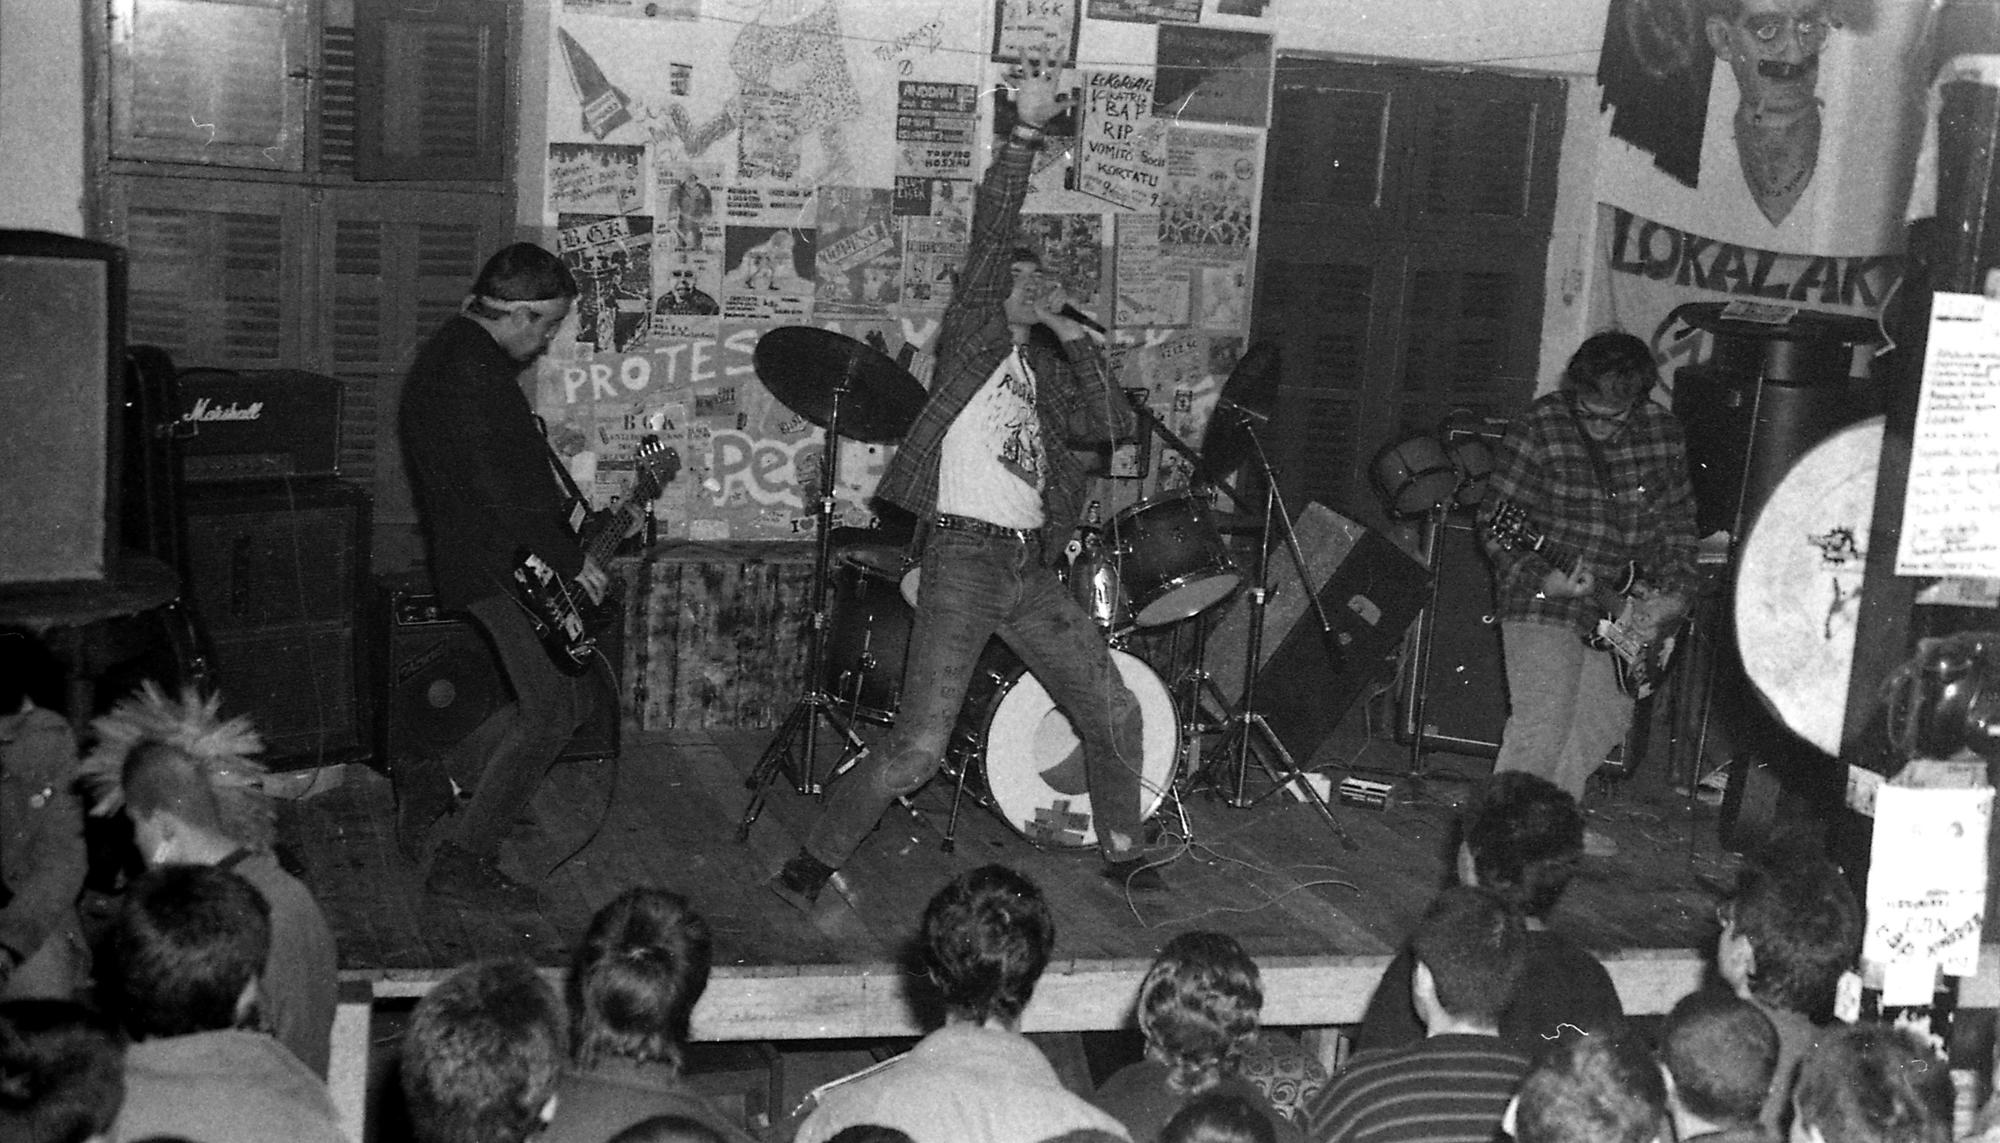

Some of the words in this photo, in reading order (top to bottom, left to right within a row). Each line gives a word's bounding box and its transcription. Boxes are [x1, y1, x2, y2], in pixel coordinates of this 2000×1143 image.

[1098, 162, 1158, 188] KORTATU
[1612, 207, 1903, 308] LOKALAK
[183, 398, 264, 421] Marshall
